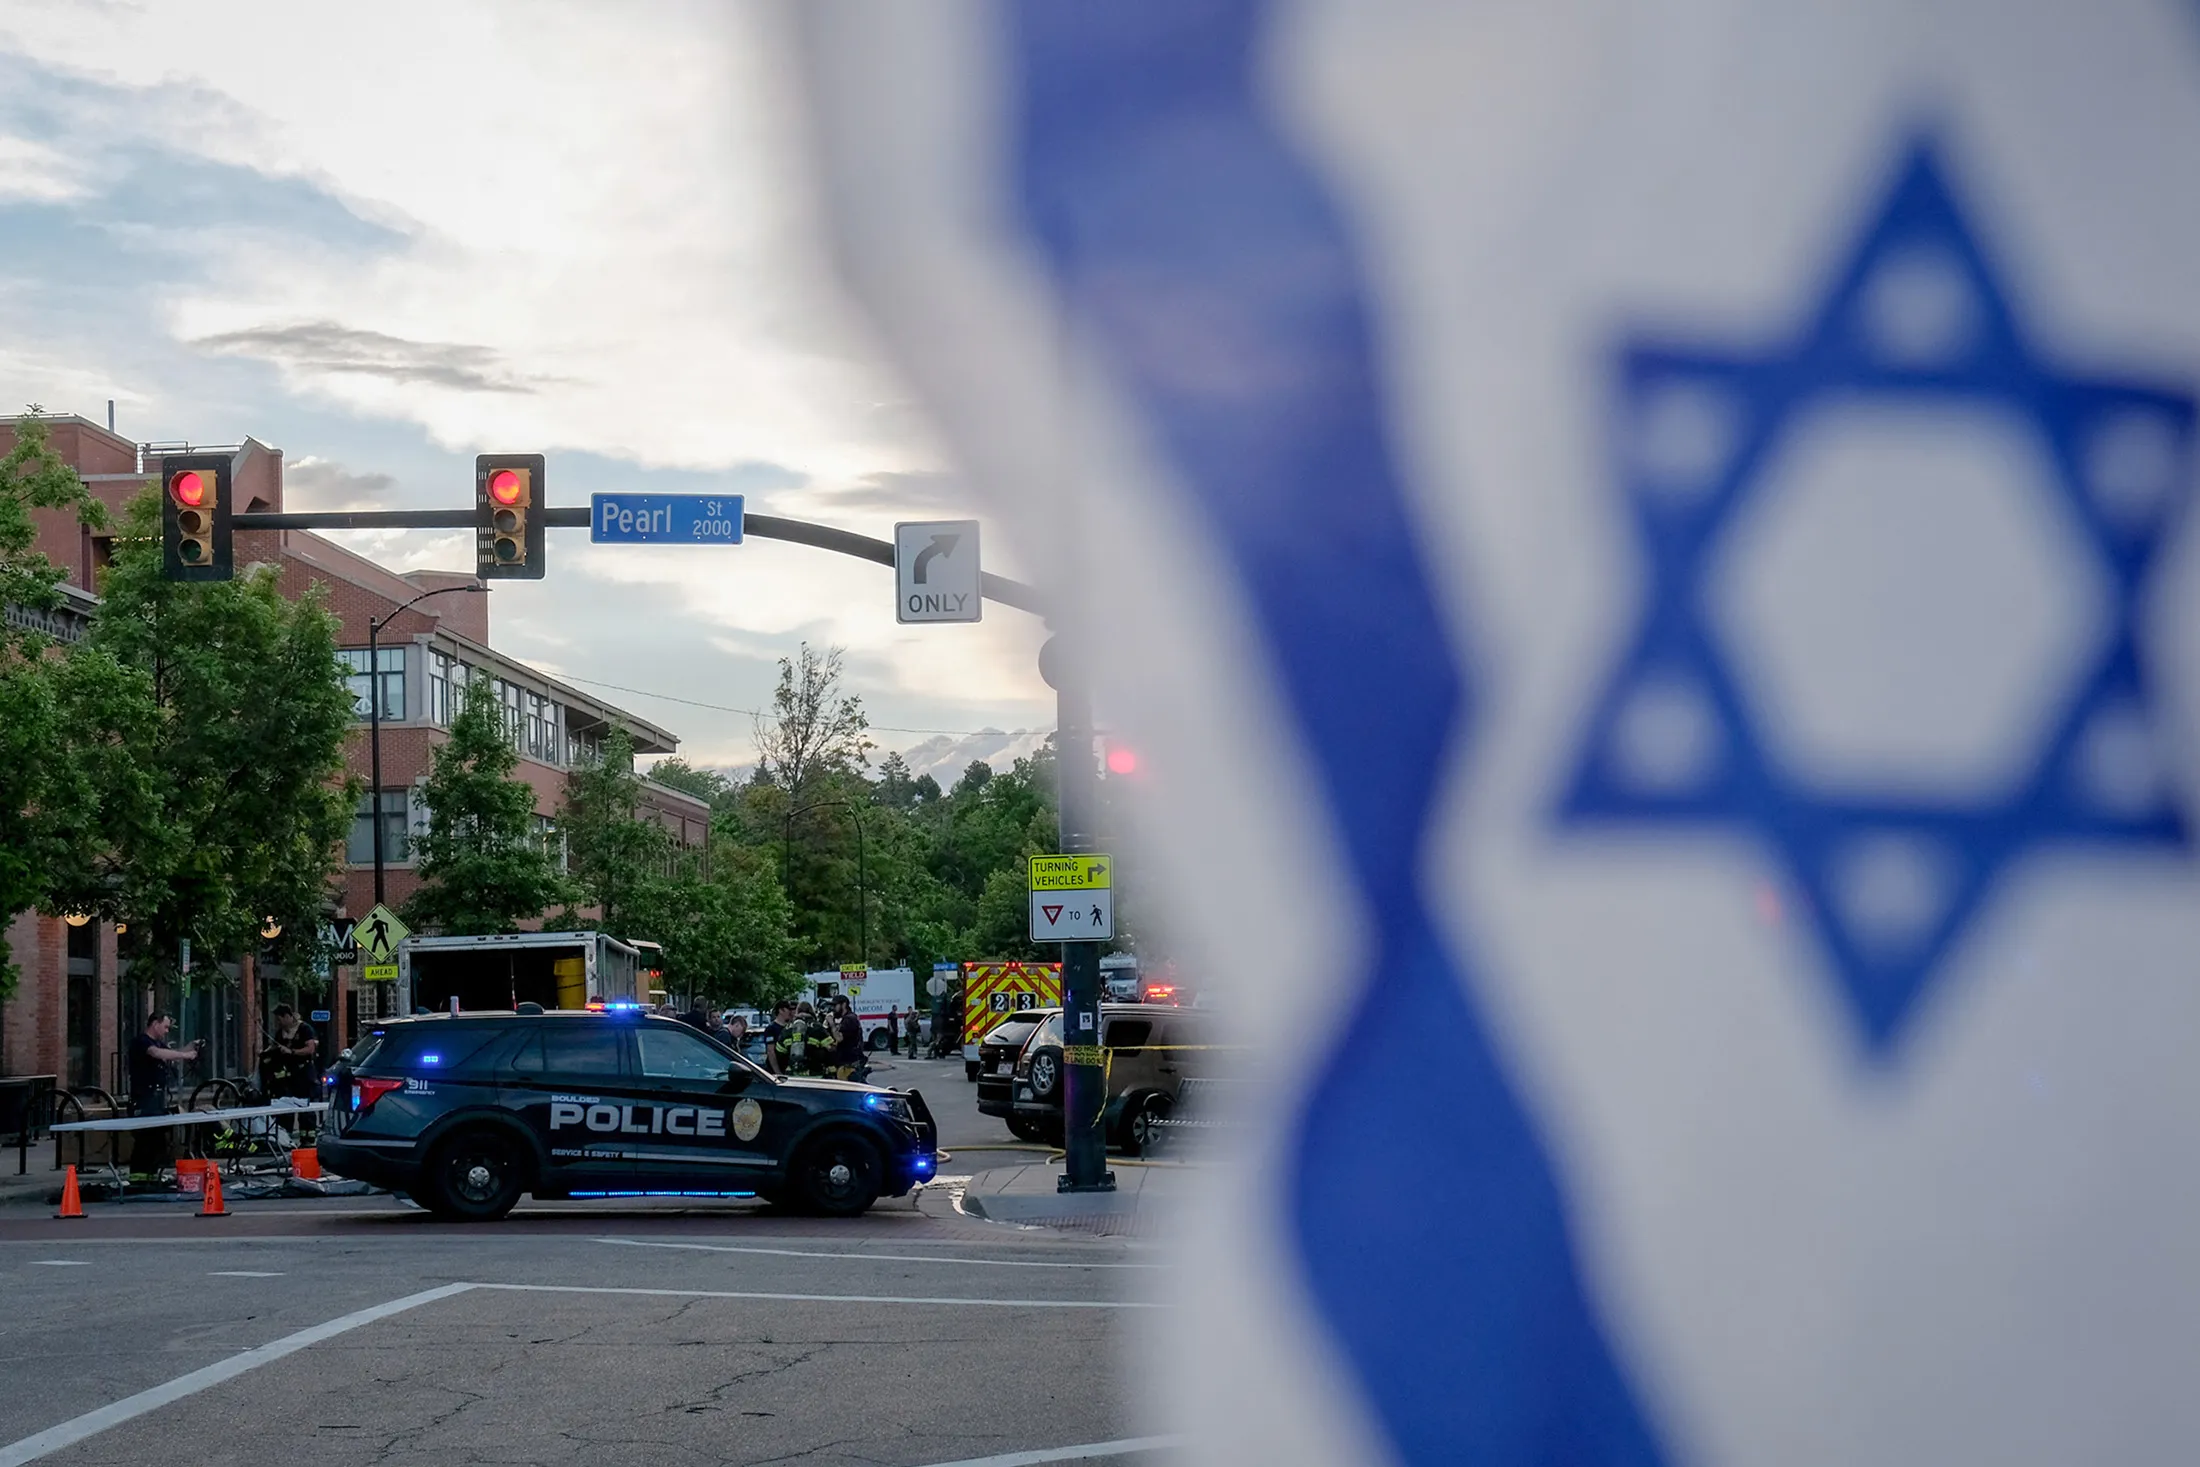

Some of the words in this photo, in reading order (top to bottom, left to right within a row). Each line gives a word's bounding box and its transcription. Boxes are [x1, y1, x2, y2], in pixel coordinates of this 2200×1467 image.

[707, 501, 722, 517] St
[602, 502, 672, 533] Pearl
[693, 519, 732, 536] 2000
[908, 593, 969, 613] ONLY
[1034, 861, 1079, 872] TURNING
[1034, 875, 1084, 886] VEHICLES
[1068, 911, 1081, 920] TO
[333, 951, 355, 960] UDIO
[370, 968, 393, 977] AHEAD
[843, 971, 865, 979] YIELD
[995, 994, 1005, 1011] 2
[1021, 994, 1031, 1011] 3
[409, 1079, 428, 1090] 911
[551, 1094, 600, 1103] BOULDER
[550, 1102, 726, 1137] POLICE
[551, 1148, 582, 1157] SERVICE
[591, 1150, 620, 1159] SAFETY
